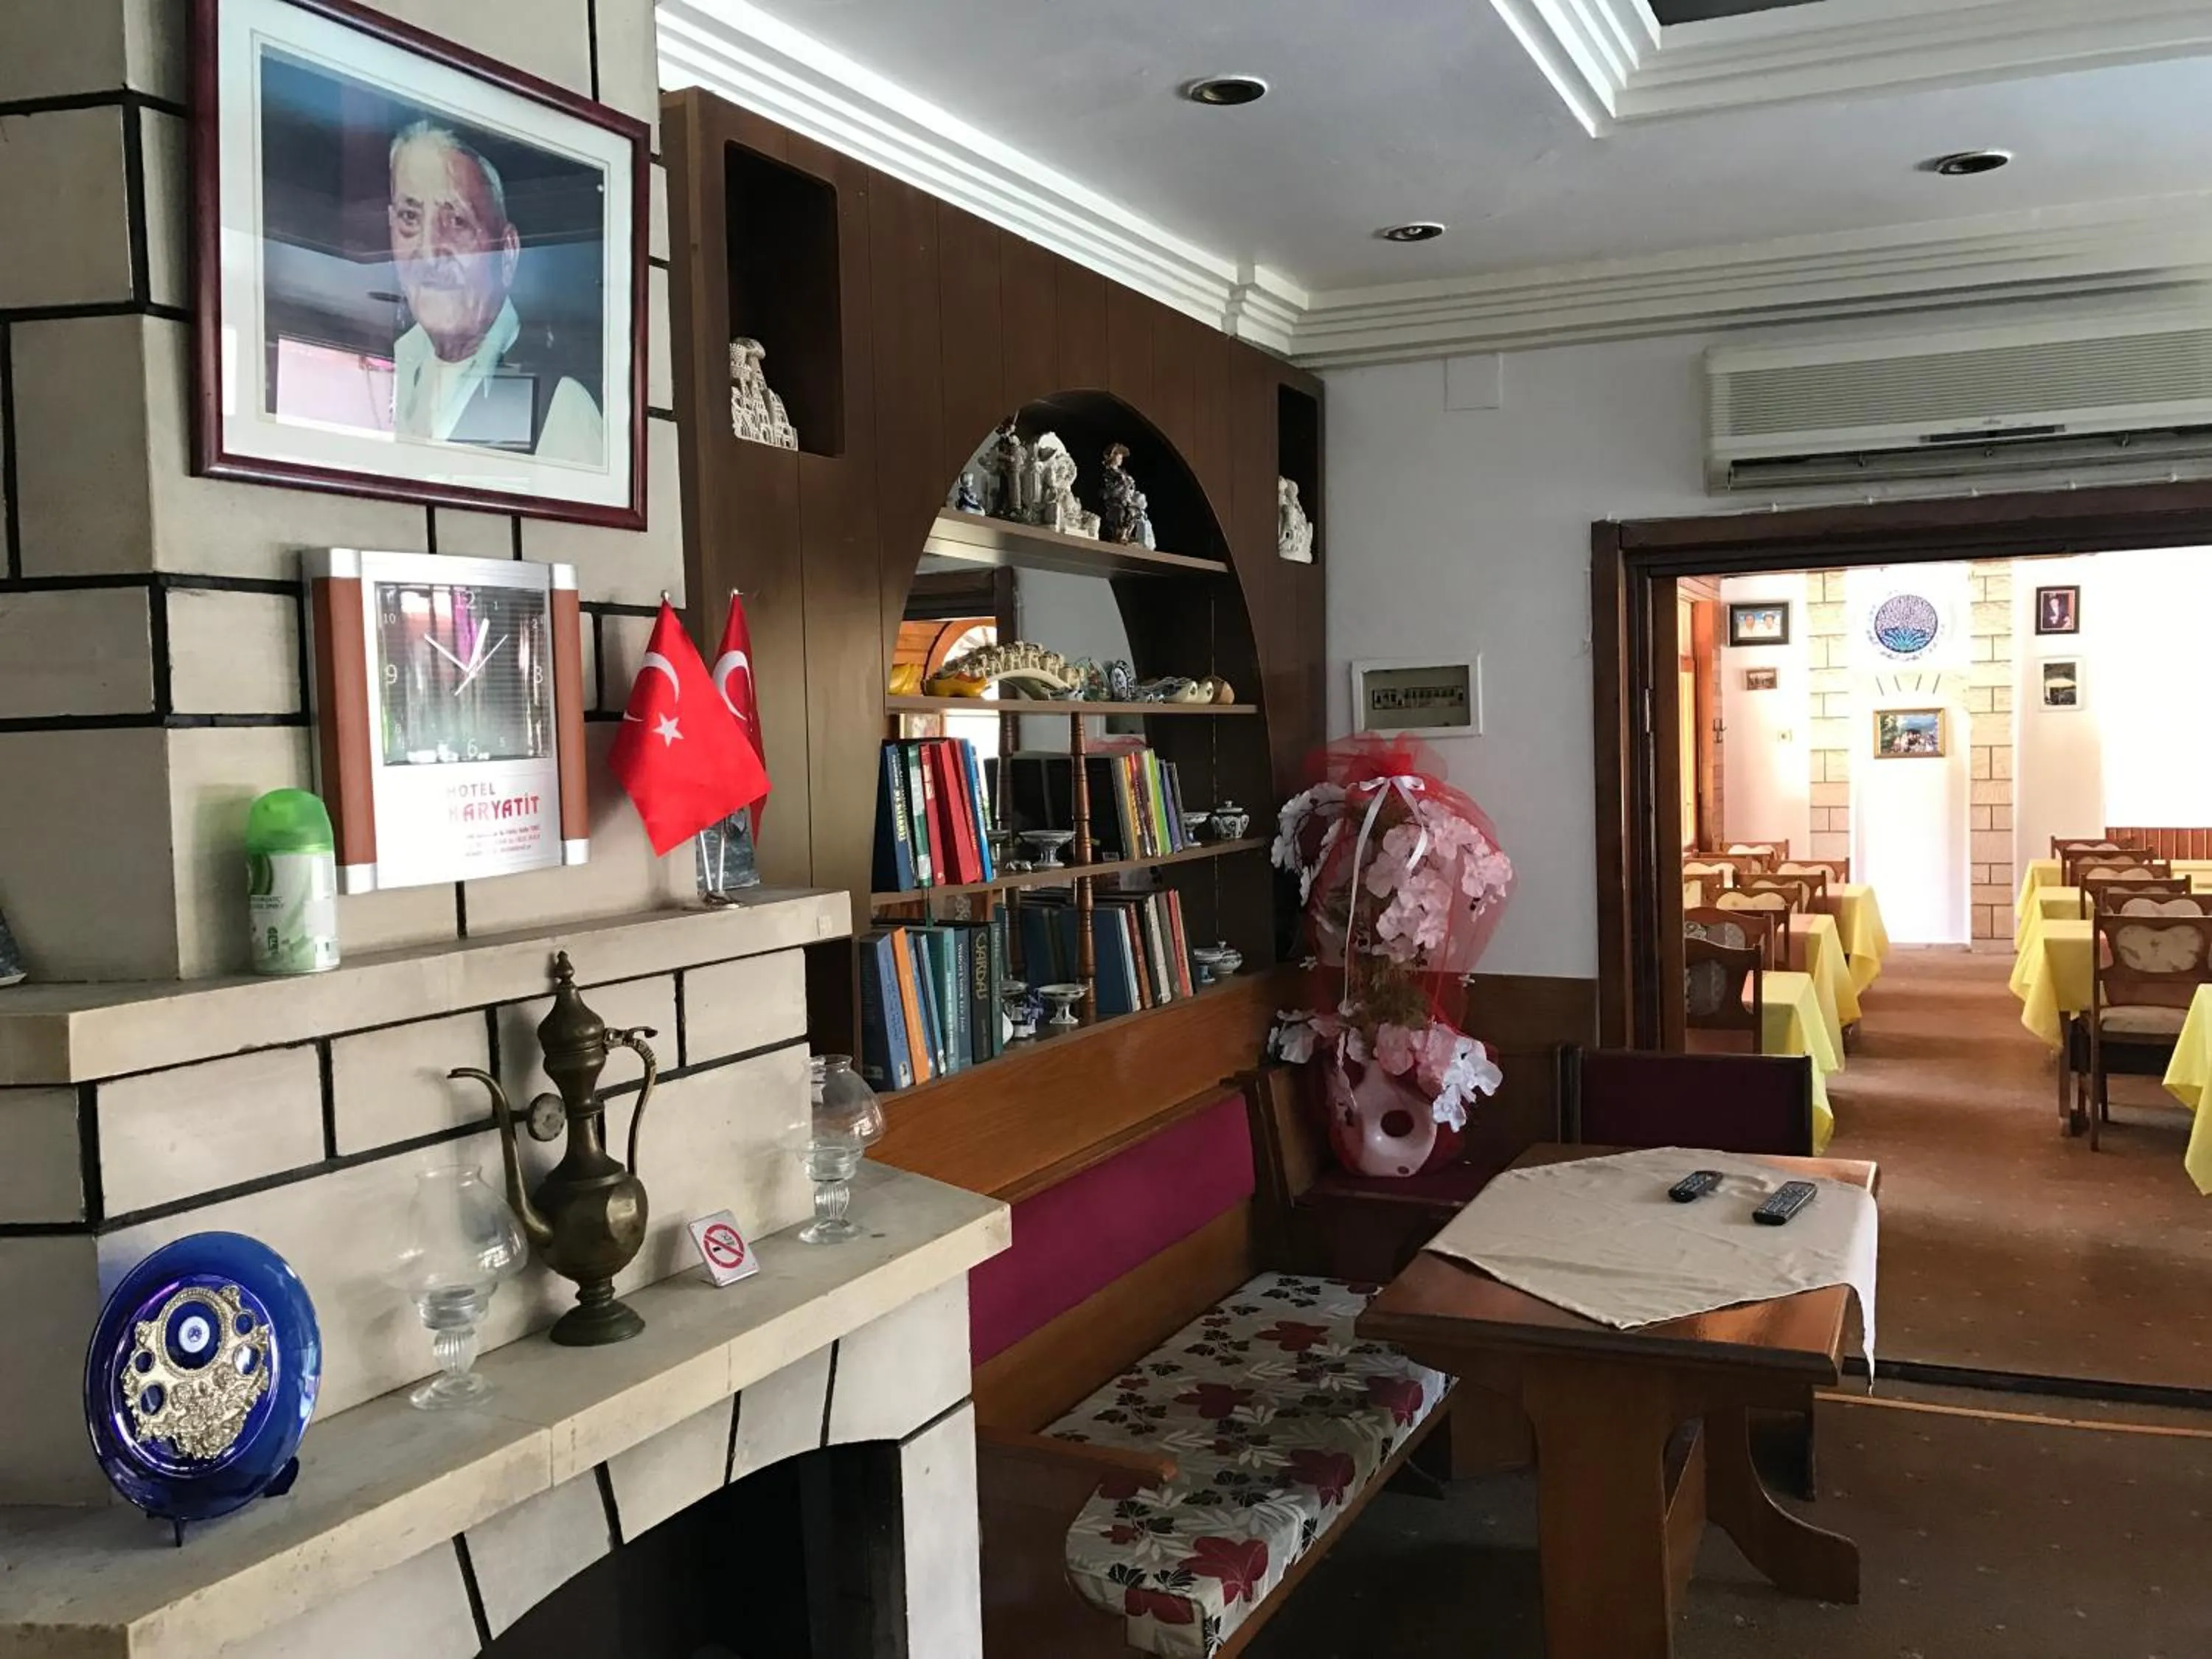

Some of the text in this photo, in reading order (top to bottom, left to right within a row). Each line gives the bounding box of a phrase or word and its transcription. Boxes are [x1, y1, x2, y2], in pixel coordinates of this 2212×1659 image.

[383, 613, 396, 625] 10
[386, 664, 397, 684] 9
[467, 737, 479, 757] 6
[447, 782, 496, 798] HOTEL
